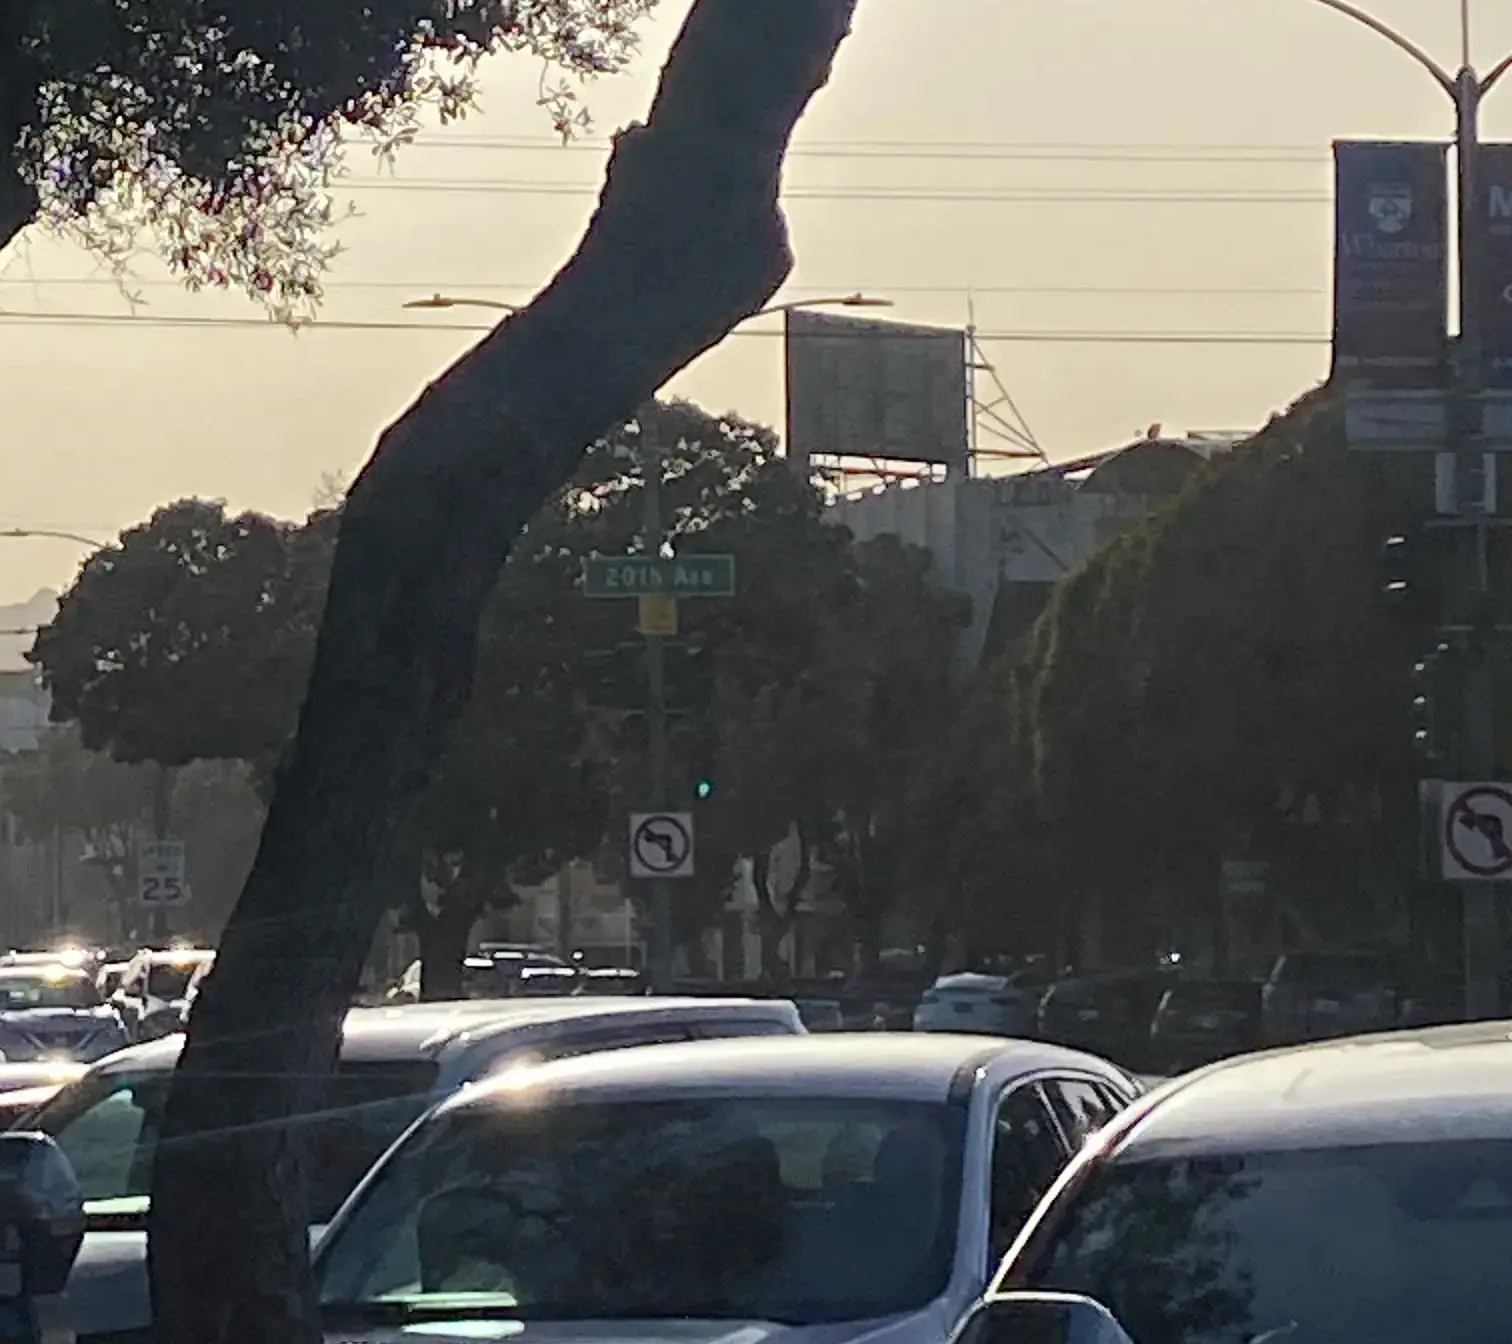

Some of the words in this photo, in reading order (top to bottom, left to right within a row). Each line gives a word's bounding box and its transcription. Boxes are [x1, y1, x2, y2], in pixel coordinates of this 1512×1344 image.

[604, 566, 663, 587] 20th
[673, 565, 714, 587] Ave
[142, 876, 182, 902] 25
